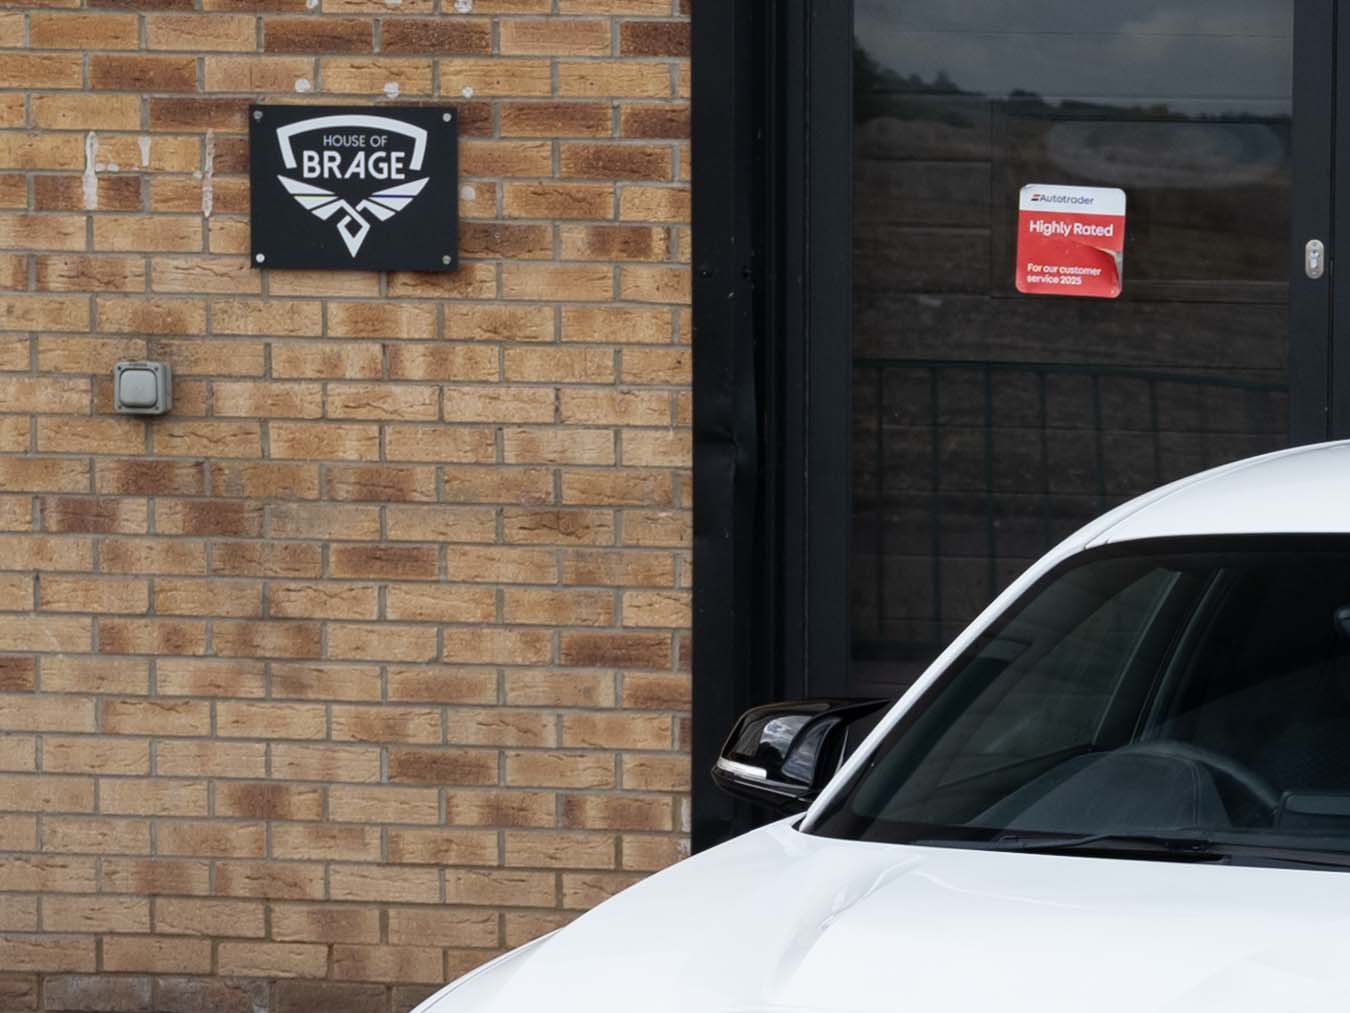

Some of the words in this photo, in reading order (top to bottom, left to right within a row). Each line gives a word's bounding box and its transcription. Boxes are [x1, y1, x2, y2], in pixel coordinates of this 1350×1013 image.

[323, 135, 366, 147] HOUSE
[370, 135, 388, 147] OF
[302, 150, 406, 180] BRAGE
[1039, 194, 1094, 205] Autotrader
[1029, 220, 1072, 237] Highly
[1073, 222, 1114, 237] Rated
[1027, 263, 1042, 272] For
[1059, 267, 1102, 276] customer
[1027, 275, 1059, 284] service
